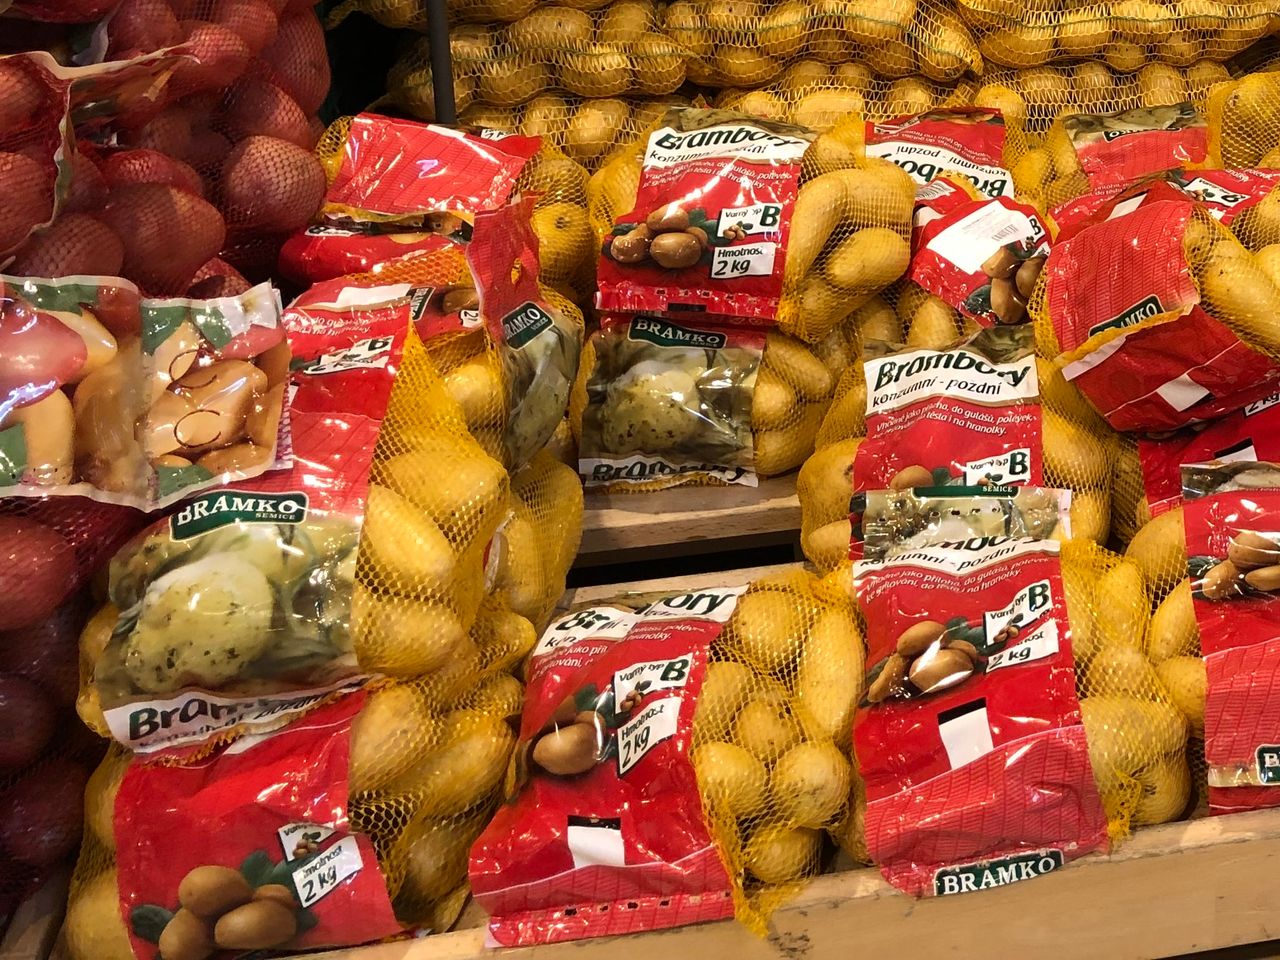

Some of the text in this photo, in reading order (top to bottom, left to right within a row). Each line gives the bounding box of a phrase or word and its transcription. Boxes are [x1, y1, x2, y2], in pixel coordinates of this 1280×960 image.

[895, 145, 941, 158] pozdní
[759, 205, 781, 228] B
[1029, 217, 1042, 236] B
[714, 259, 751, 276] 2 kg
[503, 308, 542, 341] RAMKO
[635, 318, 720, 343] BRAMKO
[872, 376, 1002, 408] konzumní pozdní
[951, 405, 964, 415] do
[953, 417, 965, 427] na
[965, 419, 1007, 436] hranolky.
[1009, 451, 1029, 476] B
[177, 495, 298, 526] BRAMKO
[255, 511, 296, 520] SEMICE
[957, 543, 1017, 572] pozdní
[900, 569, 923, 582] jako
[963, 575, 977, 586] do
[920, 580, 935, 591] do
[1028, 582, 1050, 611] B
[990, 646, 1032, 667] 2 kg
[619, 658, 690, 682] Varný typ B
[621, 702, 665, 741] Hmotnost
[621, 726, 651, 769] 2 kg
[302, 864, 338, 904] 2 kg
[943, 856, 1055, 895] BRAMKO
